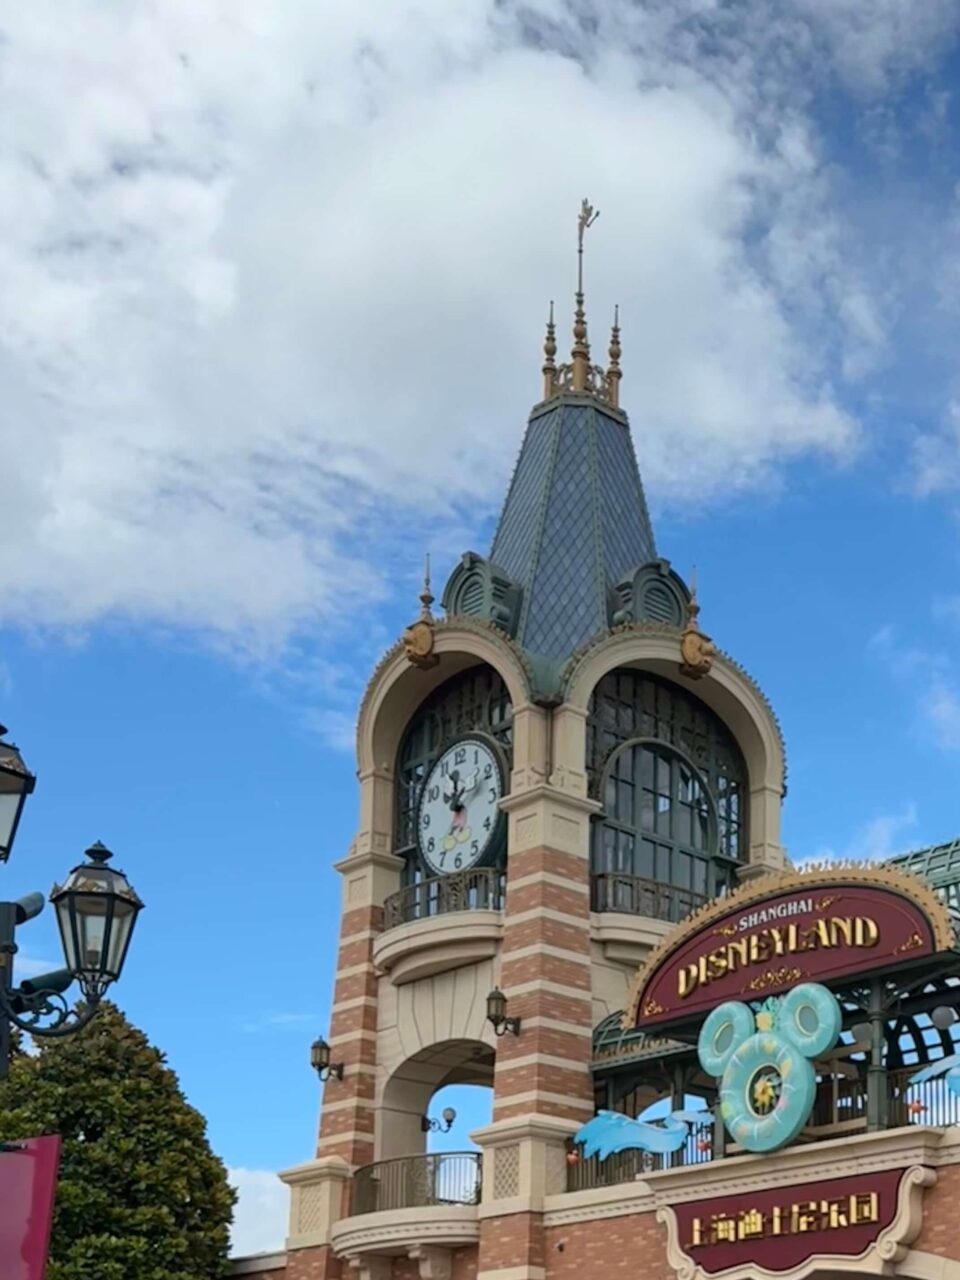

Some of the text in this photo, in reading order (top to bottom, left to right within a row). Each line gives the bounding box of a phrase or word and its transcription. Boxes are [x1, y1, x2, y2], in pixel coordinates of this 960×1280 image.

[454, 747, 466, 766] 12
[473, 749, 479, 765] 1
[440, 761, 449, 778] 11
[484, 763, 492, 780] 2
[427, 785, 440, 804] 10
[488, 787, 497, 805] 3
[422, 814, 431, 830] 9
[483, 816, 491, 831] 4
[427, 837, 435, 853] 8
[470, 840, 479, 857] 5
[439, 850, 447, 867] 7
[454, 852, 462, 869] 6
[738, 899, 813, 932] SHANGHAI
[678, 916, 880, 998] DISNEYLAND
[683, 1192, 879, 1250] 上海迪士尼乐园
